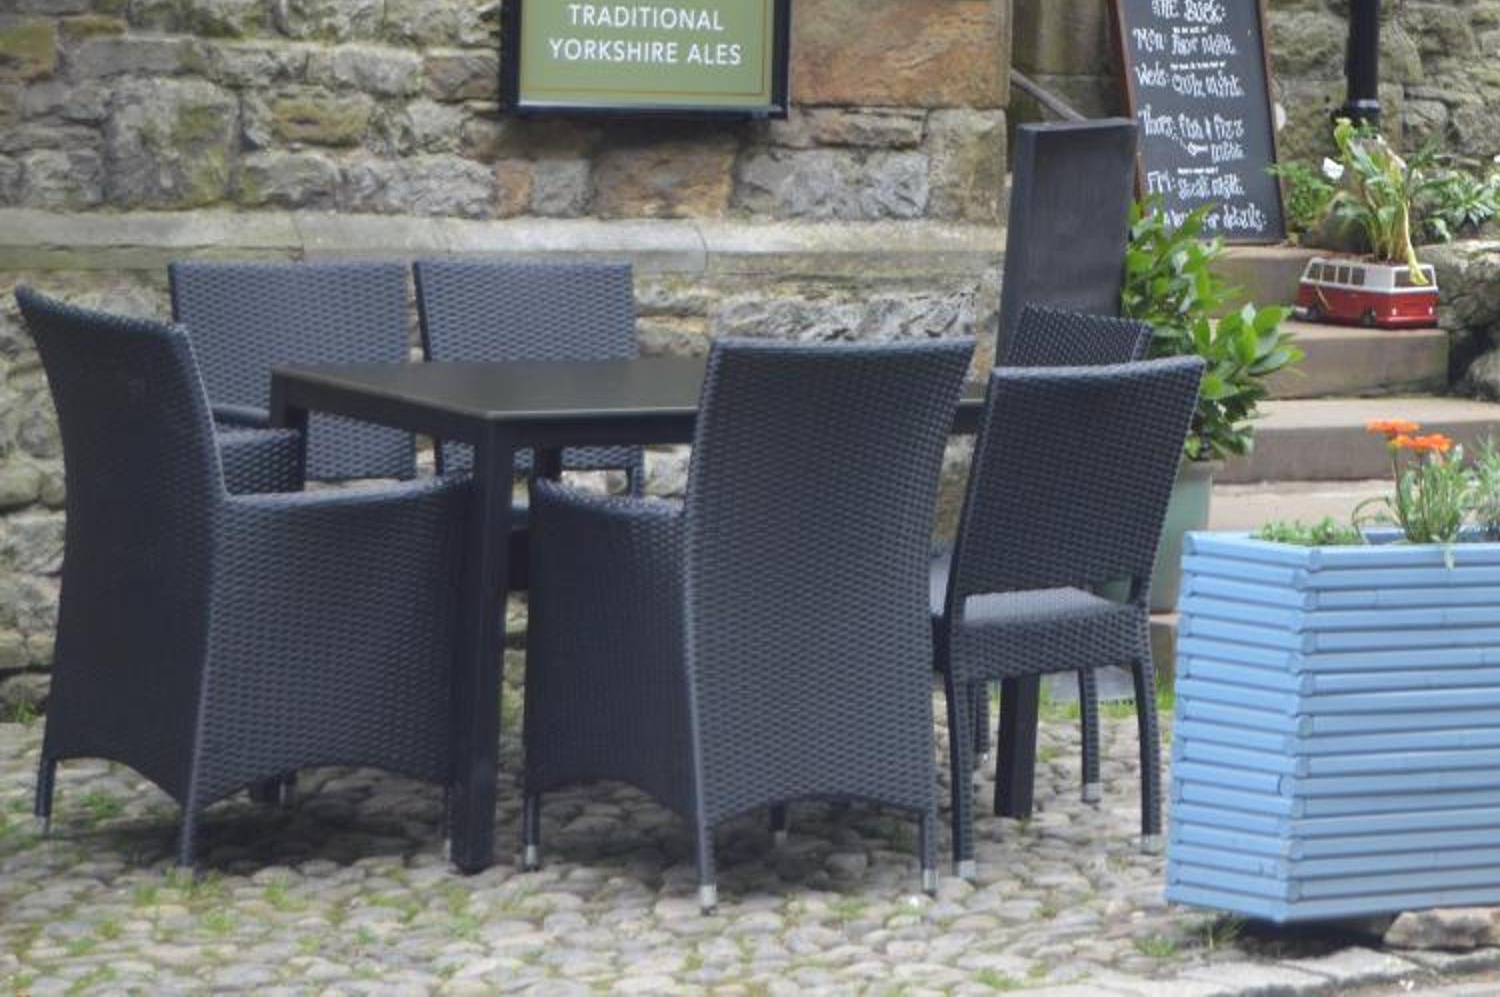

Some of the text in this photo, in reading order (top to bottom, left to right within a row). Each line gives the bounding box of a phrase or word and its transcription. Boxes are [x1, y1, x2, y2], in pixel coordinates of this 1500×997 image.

[569, 4, 724, 31] TRADITIONAL
[549, 39, 741, 65] YORKSHIRE ALES
